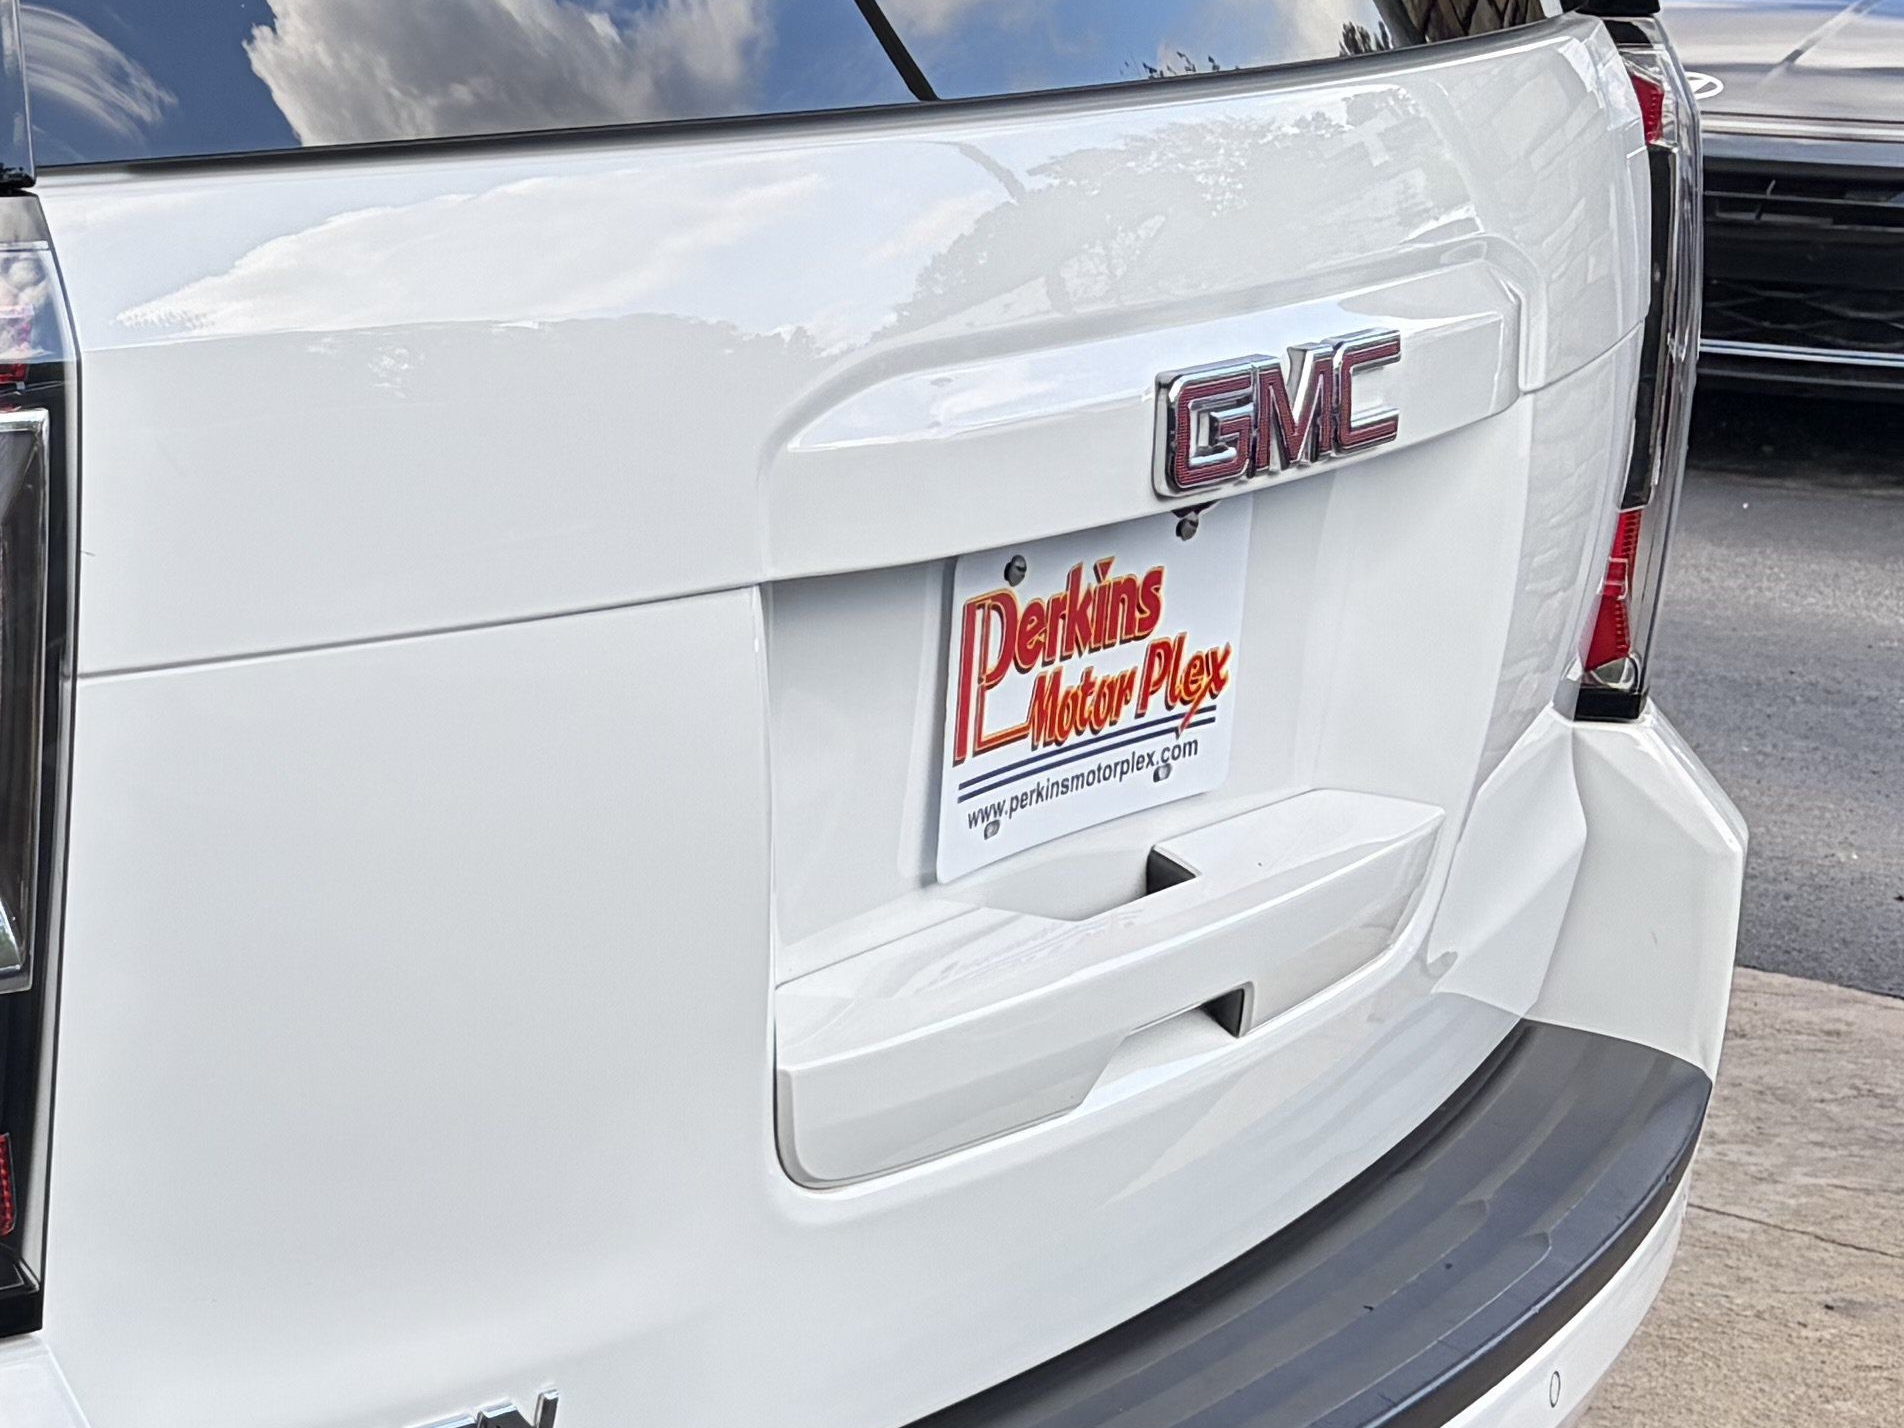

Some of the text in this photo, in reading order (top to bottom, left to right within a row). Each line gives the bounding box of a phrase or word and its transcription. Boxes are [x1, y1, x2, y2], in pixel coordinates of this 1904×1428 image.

[1152, 328, 1402, 498] GMC
[953, 557, 1166, 767] Perkins
[1028, 632, 1233, 752] Motor Plex
[968, 738, 1199, 830] www.perkinsmotorplex.com
